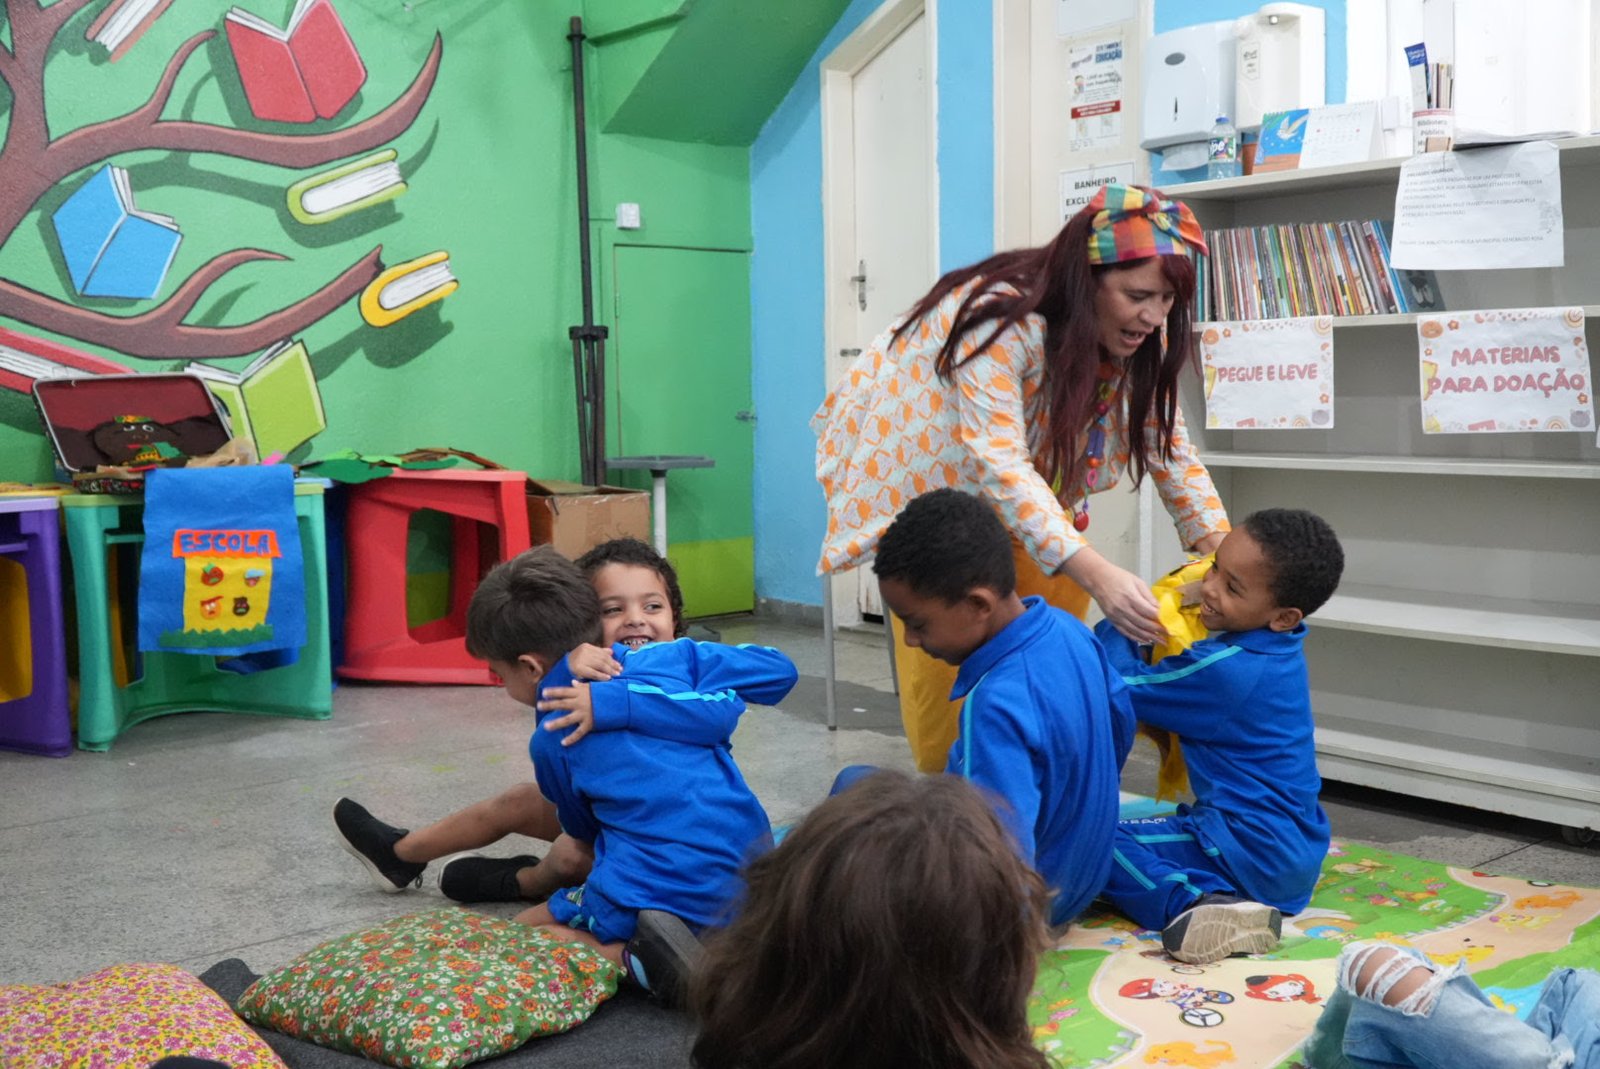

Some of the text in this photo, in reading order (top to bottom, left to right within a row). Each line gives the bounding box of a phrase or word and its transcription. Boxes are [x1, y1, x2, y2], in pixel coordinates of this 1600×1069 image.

[1074, 176, 1117, 190] BANHEIRO
[1451, 345, 1561, 367] MATERIAIS
[1217, 363, 1318, 383] PEGUE E LEVE
[1427, 368, 1585, 398] PARA DOAÇÃO
[180, 533, 271, 555] ESCOLA
